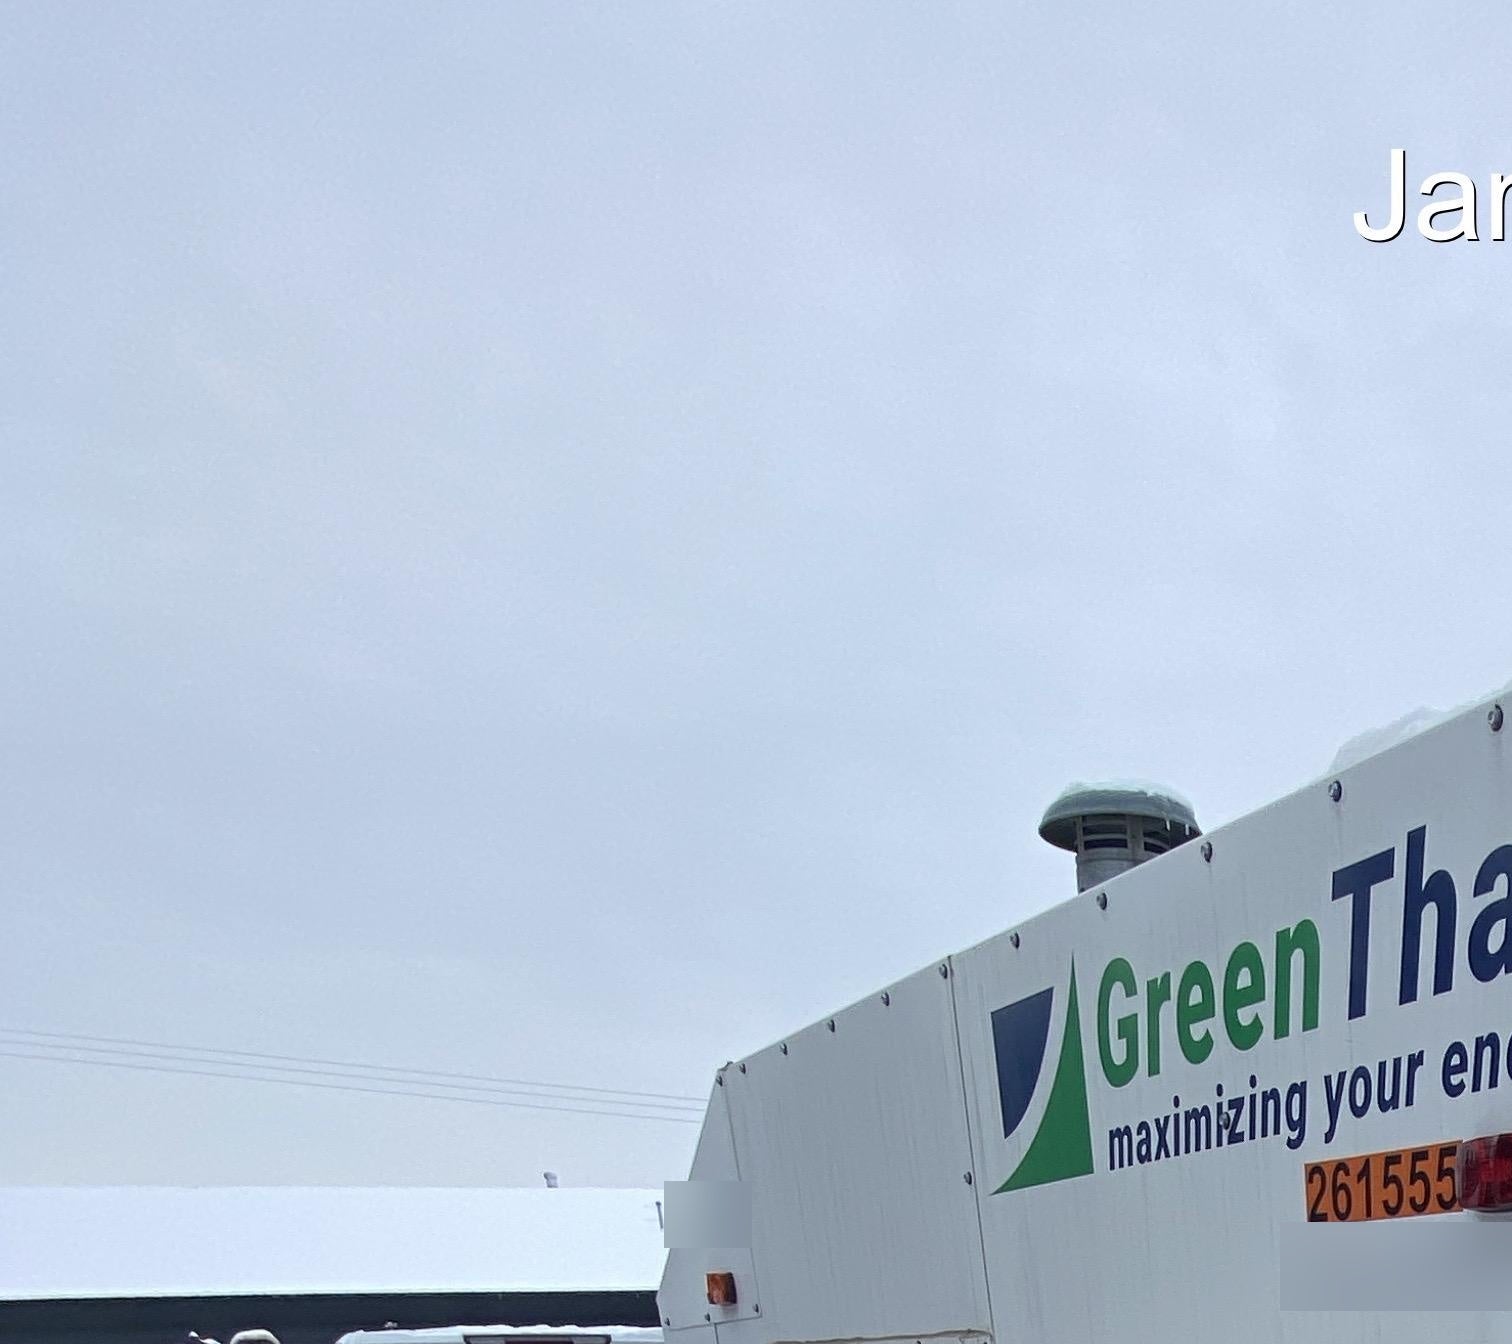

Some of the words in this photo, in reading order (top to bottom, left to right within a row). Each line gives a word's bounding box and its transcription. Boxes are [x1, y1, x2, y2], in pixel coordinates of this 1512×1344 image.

[1107, 1074, 1308, 1171] maximizing
[1323, 1048, 1425, 1145] your
[1308, 1145, 1458, 1223] 261555
